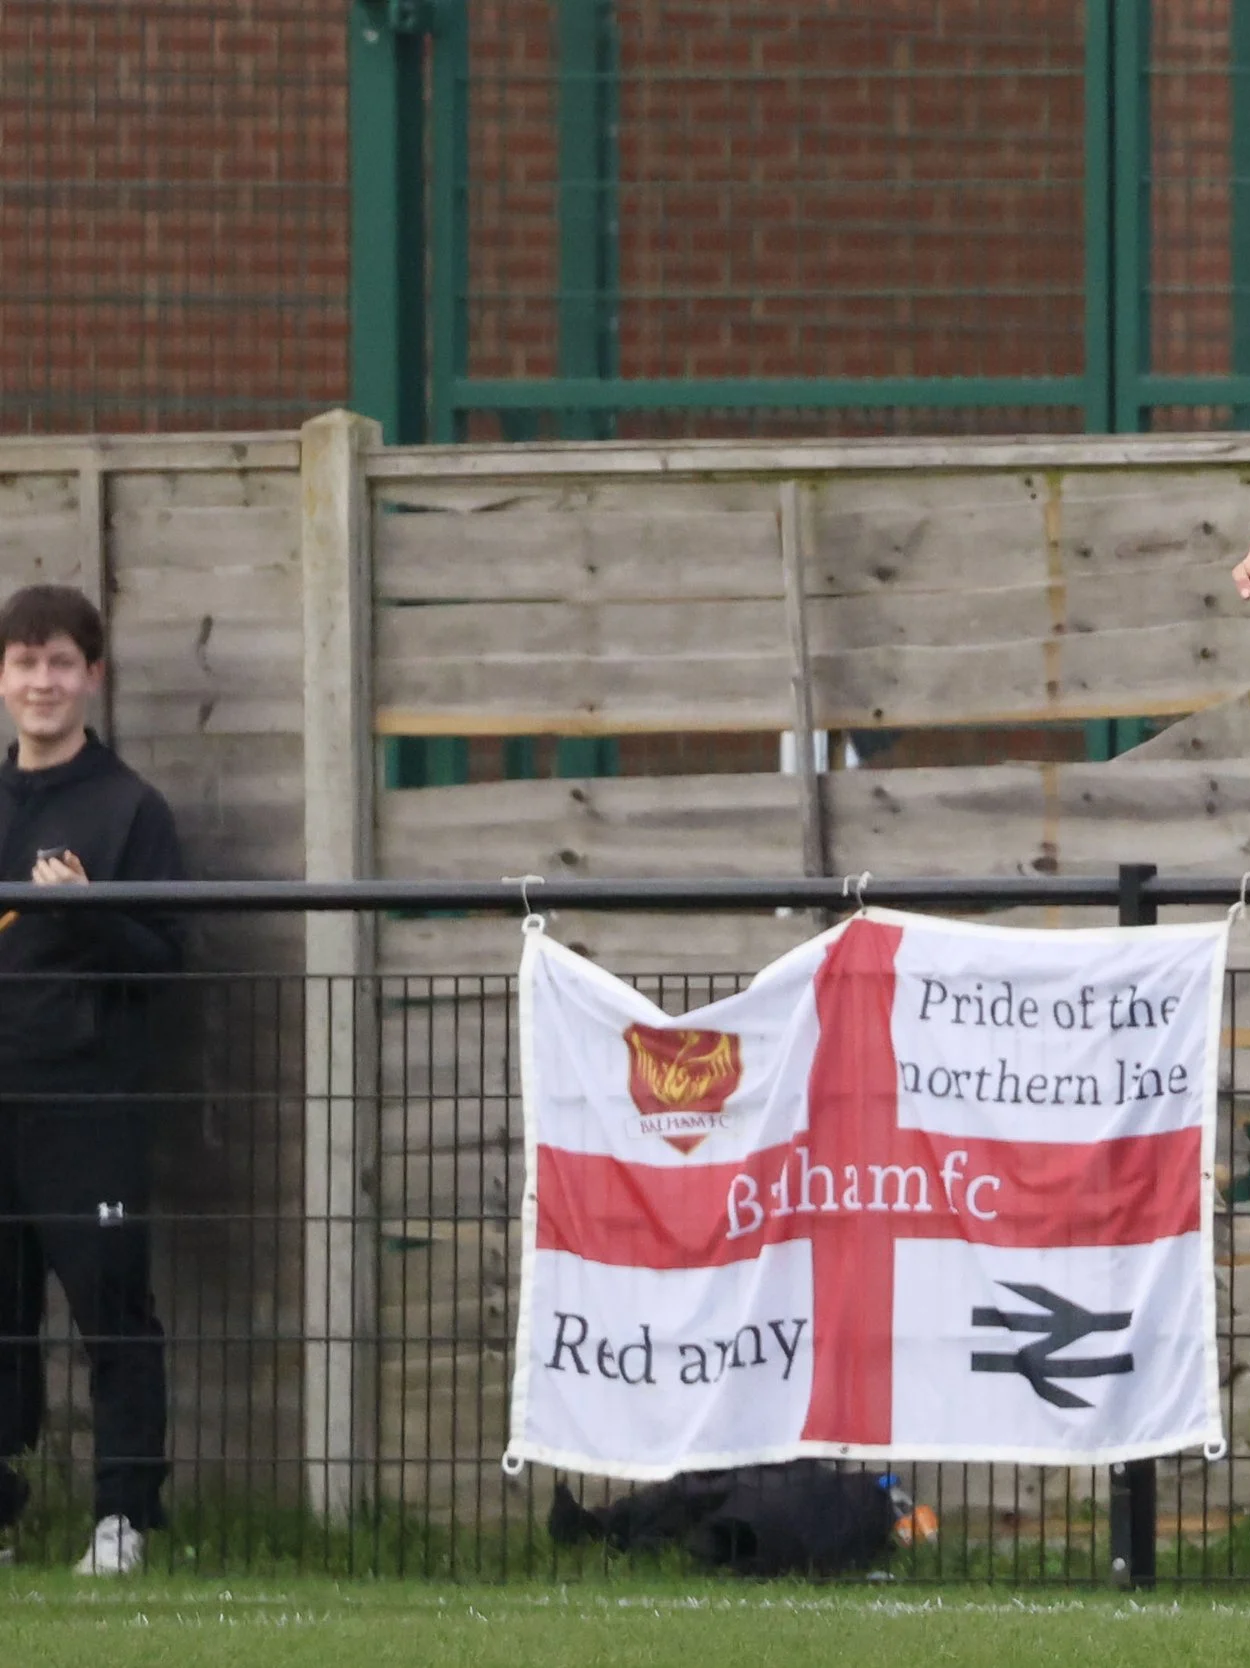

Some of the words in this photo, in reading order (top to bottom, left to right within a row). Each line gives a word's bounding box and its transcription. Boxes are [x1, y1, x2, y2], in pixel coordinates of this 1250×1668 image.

[919, 978, 1039, 1028] Pride
[1053, 985, 1096, 1030] of
[1109, 985, 1180, 1030] the
[899, 1057, 1102, 1106] northern
[1114, 1058, 1189, 1106] line
[939, 1150, 1001, 1221] fc
[544, 1310, 656, 1385] Red
